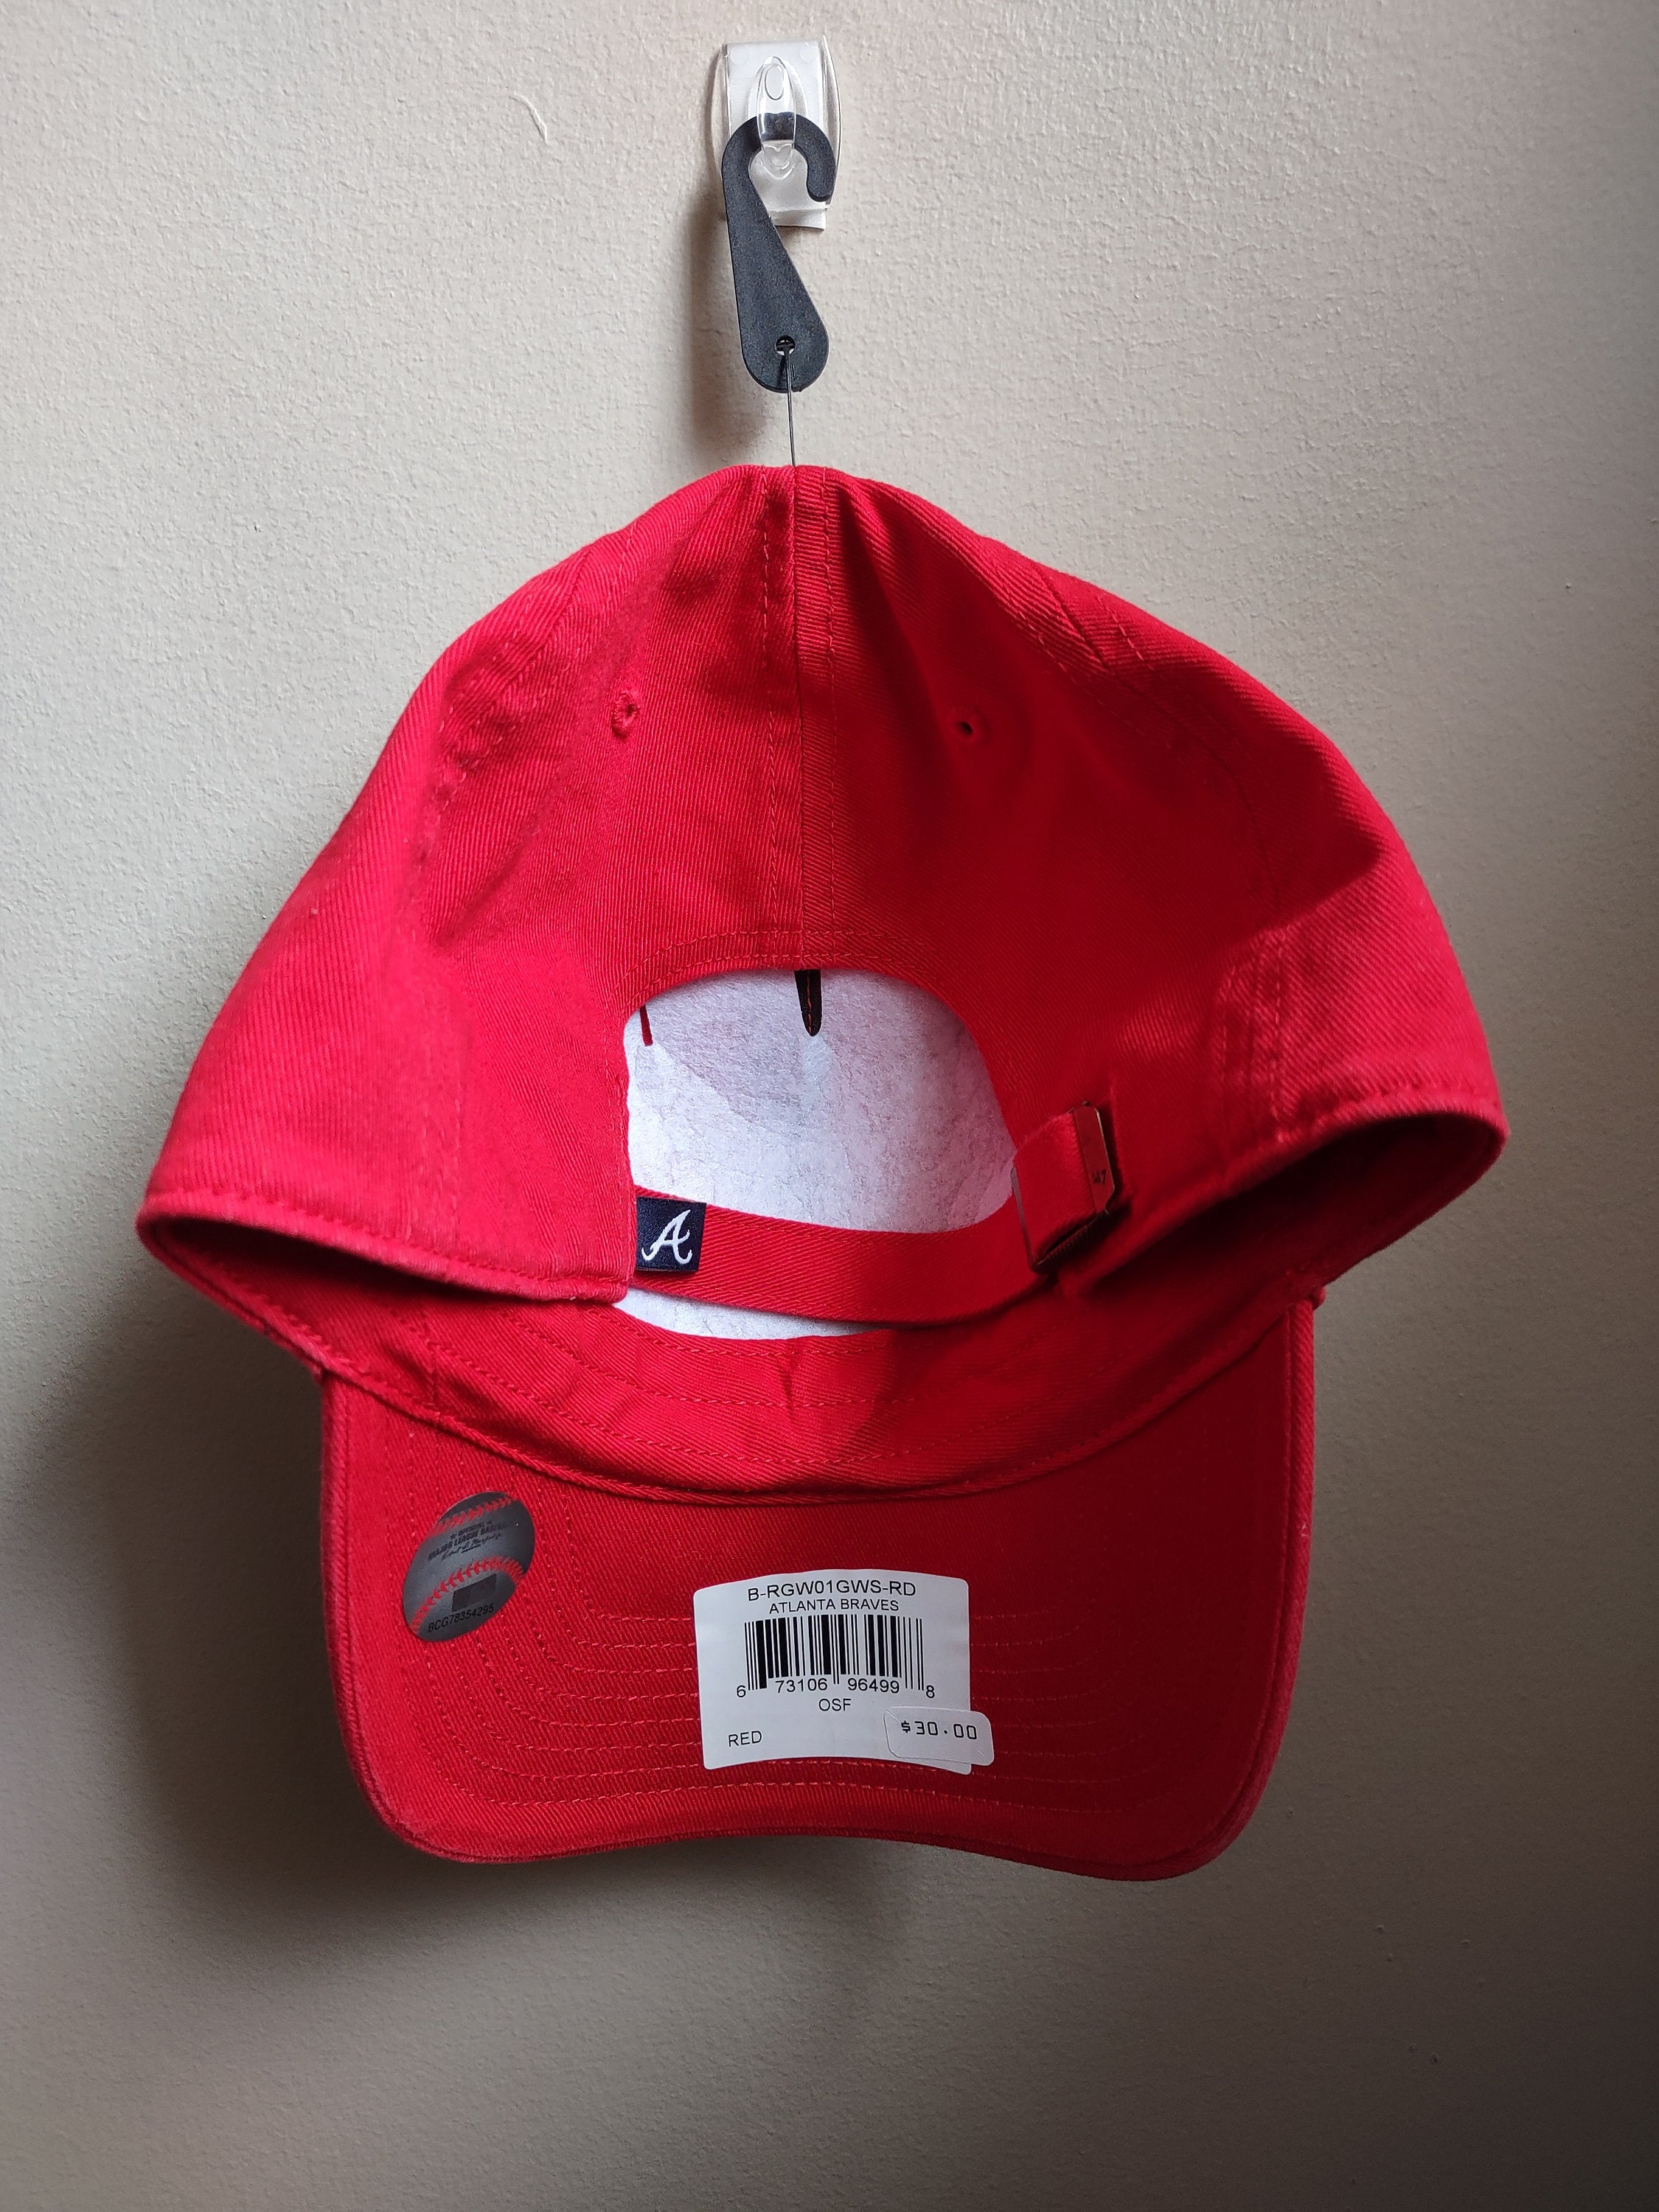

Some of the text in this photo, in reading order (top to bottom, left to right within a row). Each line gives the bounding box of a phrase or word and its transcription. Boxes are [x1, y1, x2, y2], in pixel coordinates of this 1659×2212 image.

[641, 1209, 692, 1265] A
[748, 1579, 916, 1601] B-RGW01GWS-RD
[769, 1599, 900, 1615] ATLANTA BRAVES
[736, 1677, 936, 1699] 6 73106 96499 8
[818, 1698, 852, 1711] OSF
[728, 1731, 762, 1747] RED
[901, 1720, 978, 1740] $30.00
